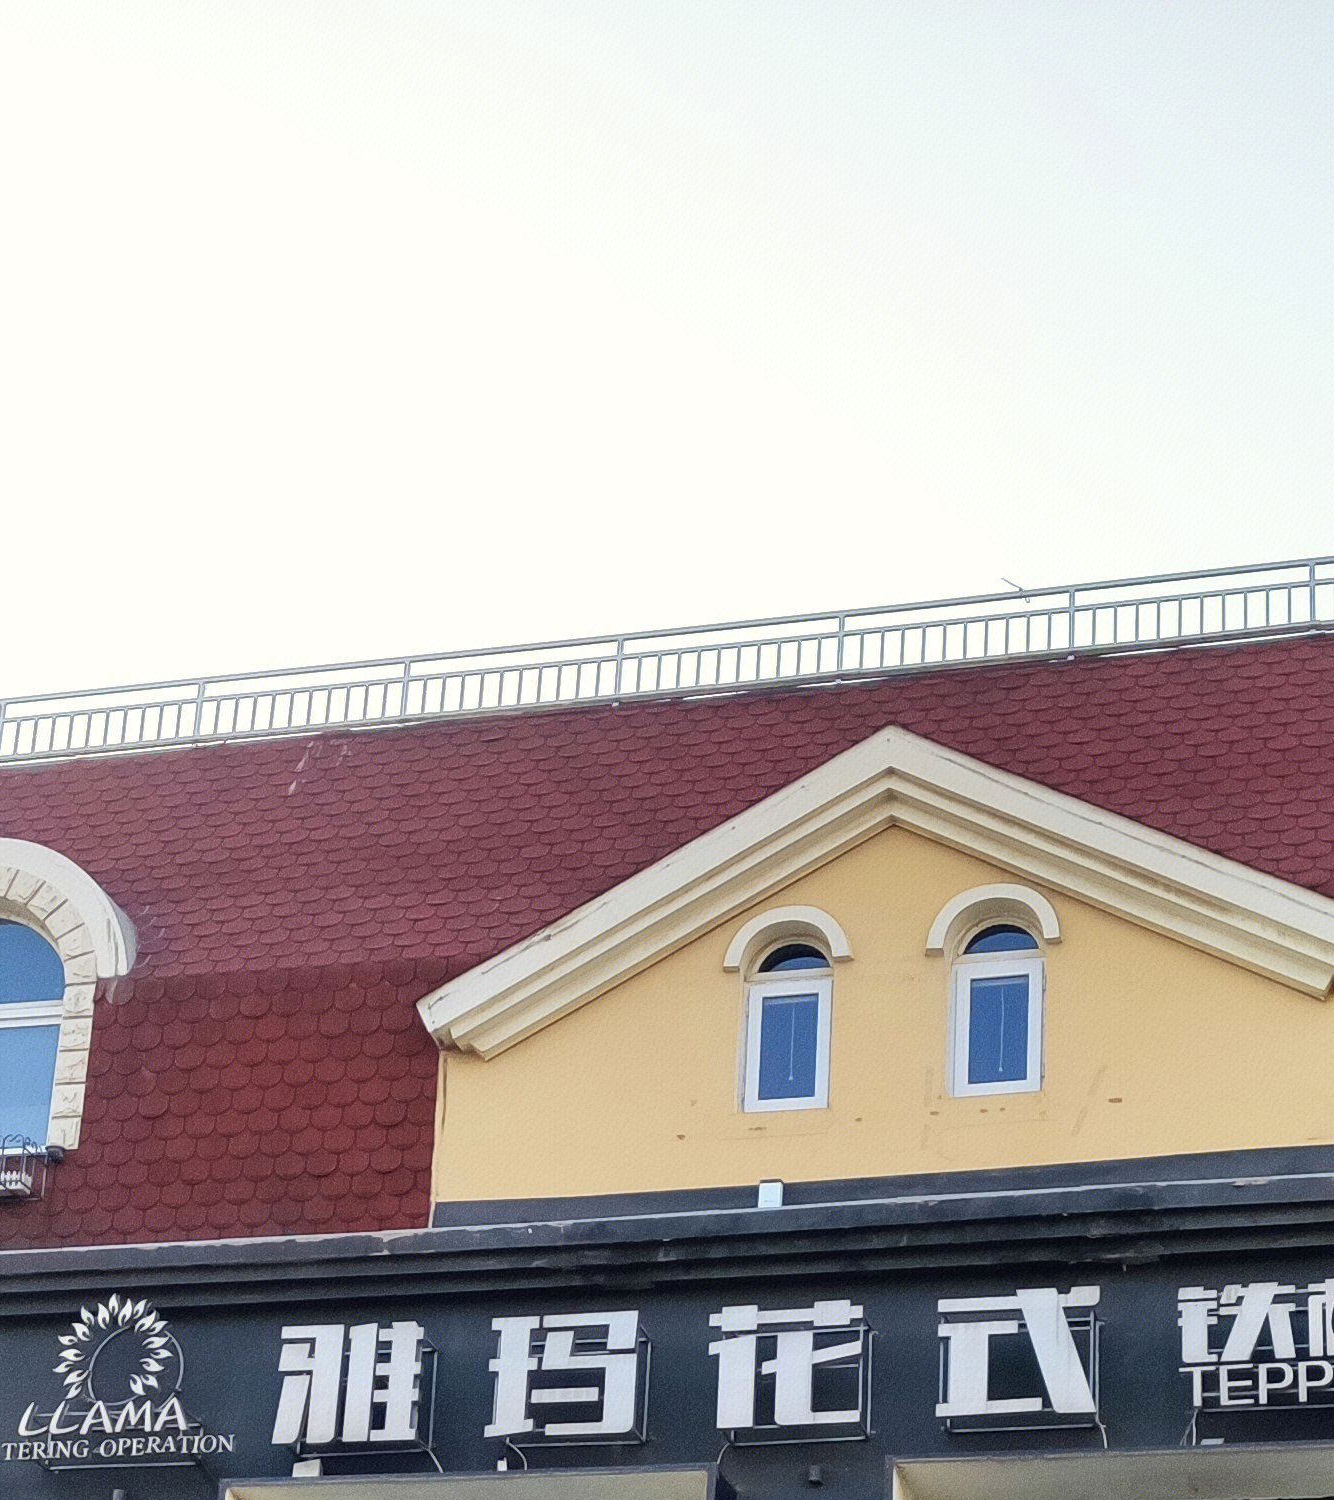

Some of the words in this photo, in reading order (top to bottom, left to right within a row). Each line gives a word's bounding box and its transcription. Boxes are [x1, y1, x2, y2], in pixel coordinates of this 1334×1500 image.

[272, 1286, 1101, 1445] 雅玛花式
[17, 1399, 189, 1438] LLAMA
[99, 1432, 235, 1458] OPERATION
